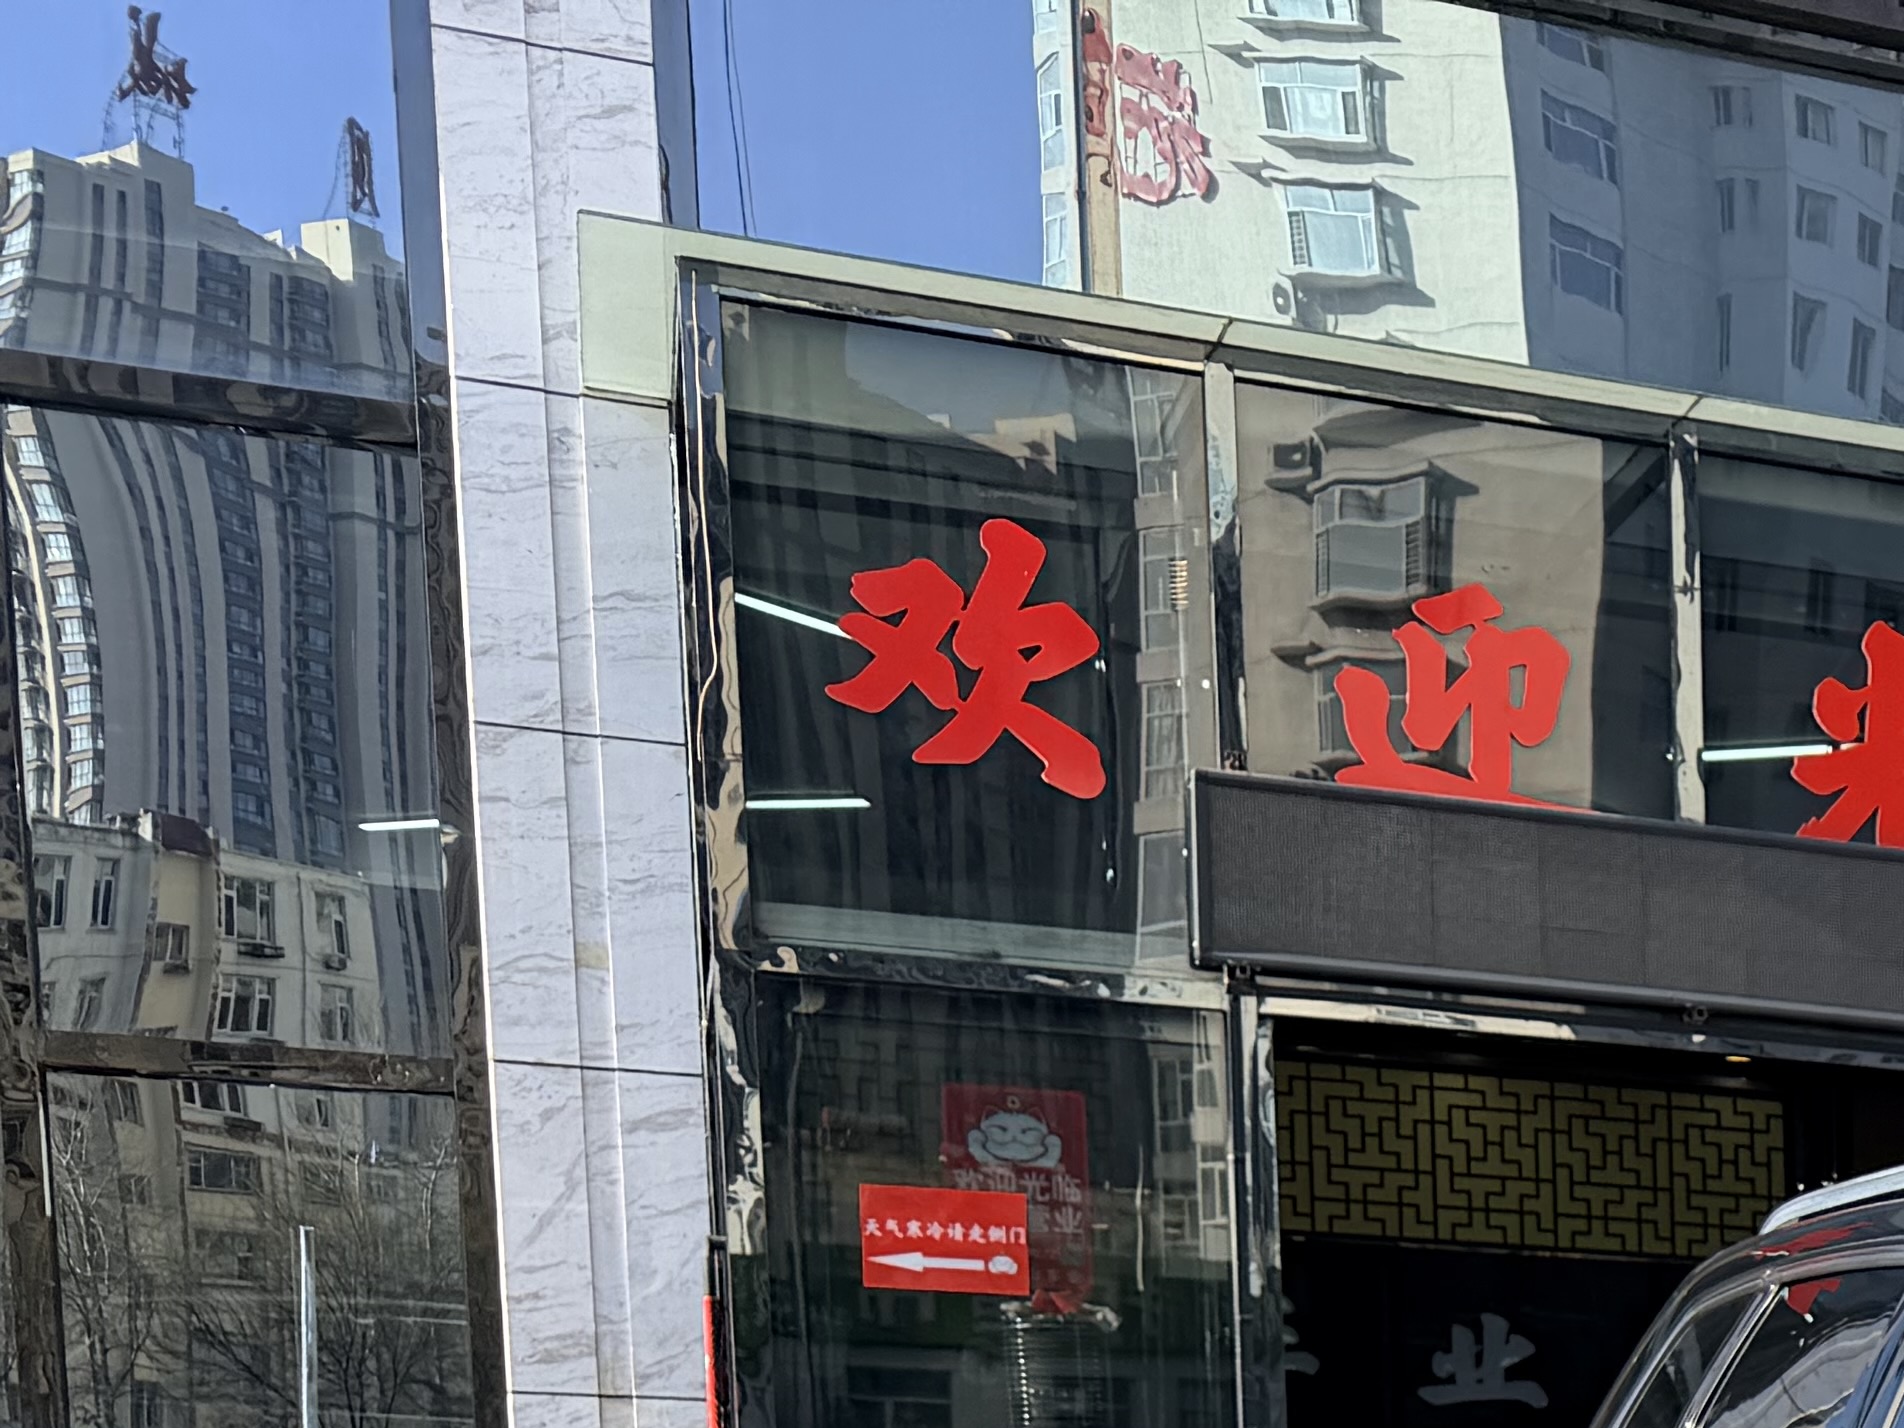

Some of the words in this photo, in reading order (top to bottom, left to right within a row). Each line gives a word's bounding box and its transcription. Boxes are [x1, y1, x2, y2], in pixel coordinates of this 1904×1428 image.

[864, 1217, 1027, 1245] 天气寒冷请走侧门
